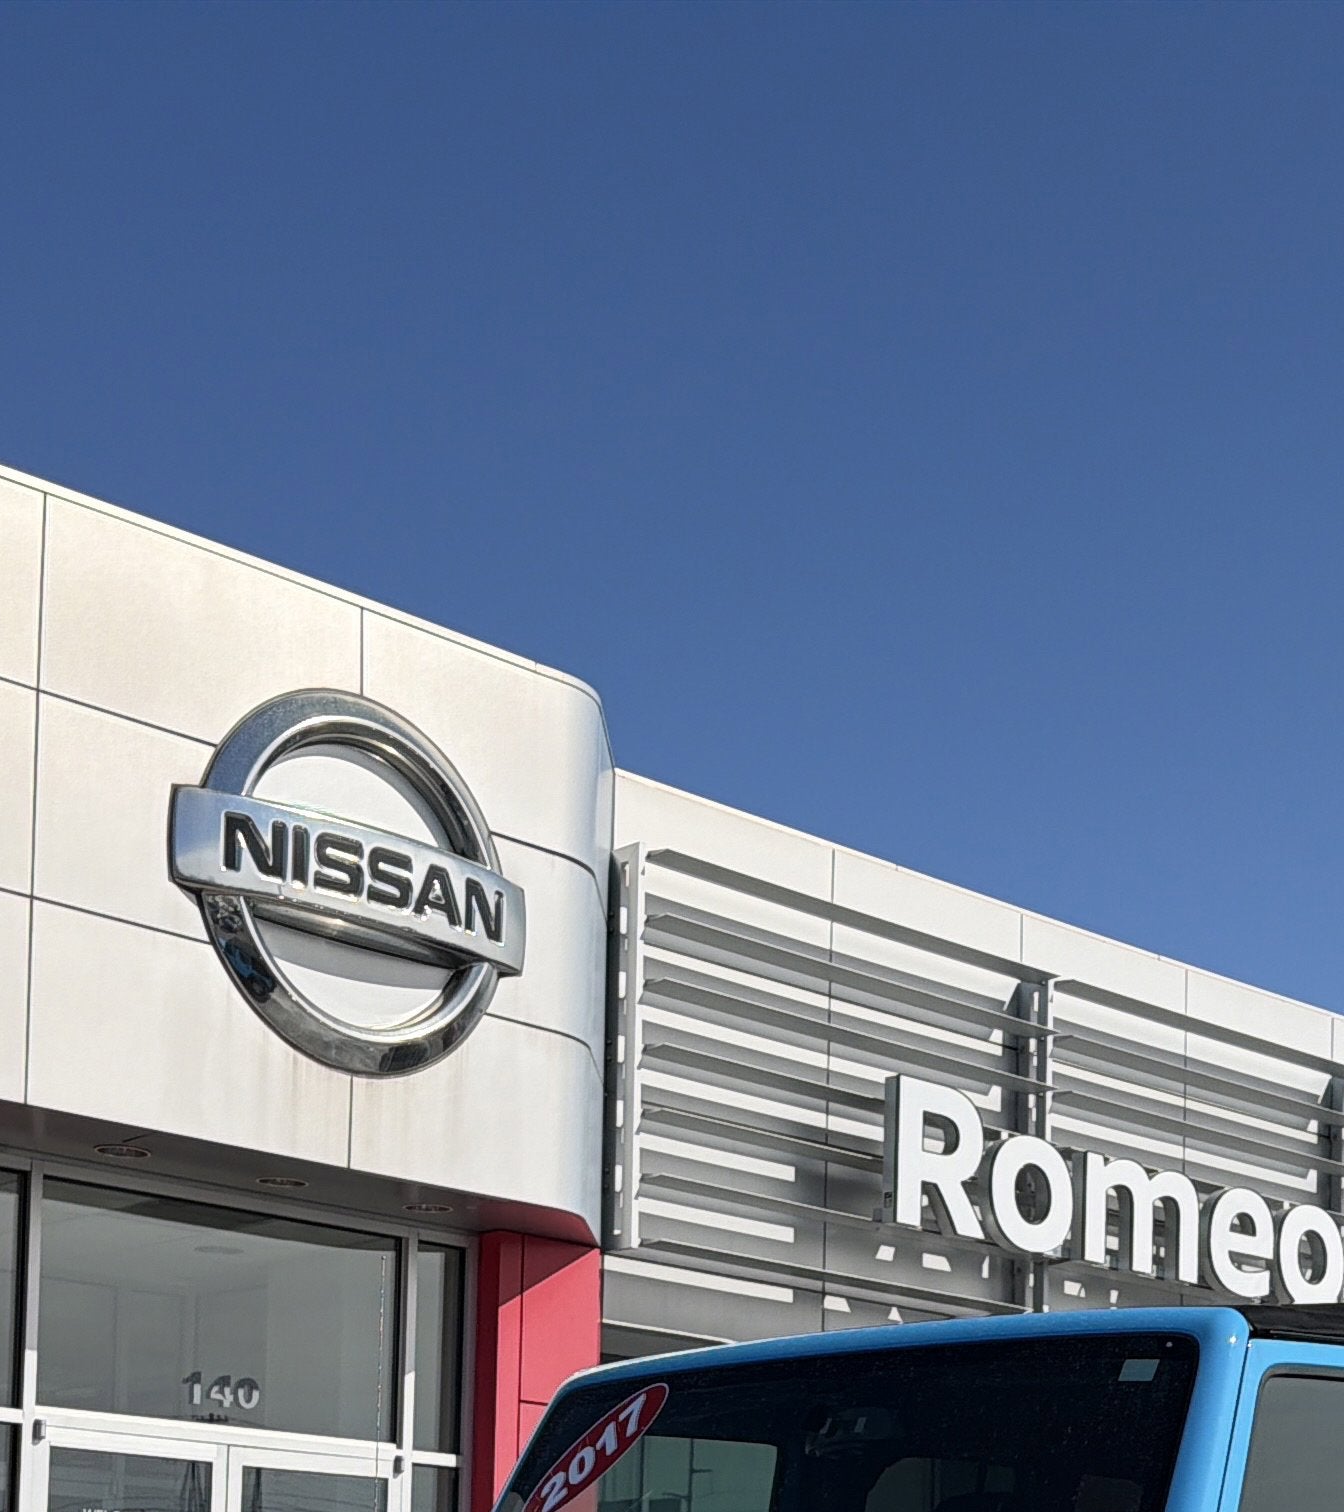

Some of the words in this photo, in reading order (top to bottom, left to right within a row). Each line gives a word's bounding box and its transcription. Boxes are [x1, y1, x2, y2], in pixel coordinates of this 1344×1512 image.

[221, 810, 506, 947] NISSAN
[884, 1074, 1344, 1304] Romeo
[182, 1371, 260, 1410] 140
